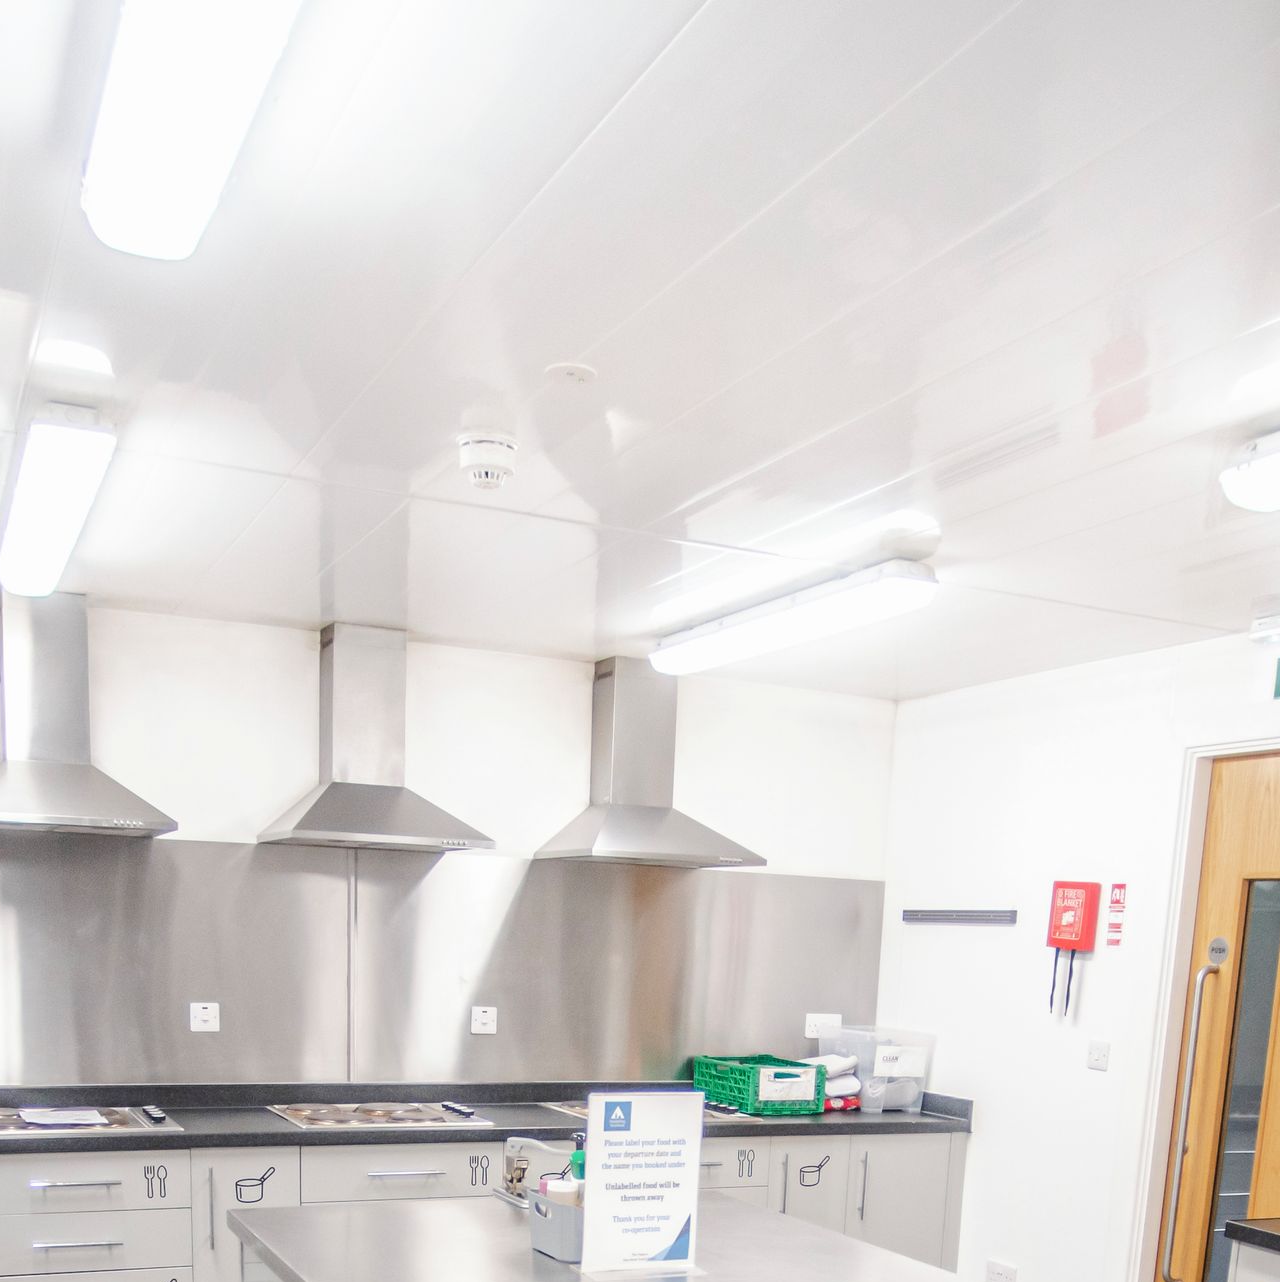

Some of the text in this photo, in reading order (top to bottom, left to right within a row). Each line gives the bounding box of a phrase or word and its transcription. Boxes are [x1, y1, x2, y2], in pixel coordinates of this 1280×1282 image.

[1064, 890, 1078, 898] FIRE
[1057, 898, 1082, 908] BLANKET
[1210, 946, 1226, 954] PUSH
[604, 1138, 686, 1148] Please label your food with
[607, 1152, 622, 1160] your
[623, 1150, 654, 1159] departure
[632, 1163, 644, 1171] you
[644, 1161, 667, 1169] booked
[604, 1182, 642, 1190] Unlabelled
[642, 1182, 658, 1190] food
[658, 1181, 672, 1189] will
[620, 1194, 664, 1202] thrown away
[612, 1214, 672, 1224] Thank you for your
[622, 1226, 662, 1234] co-operation
